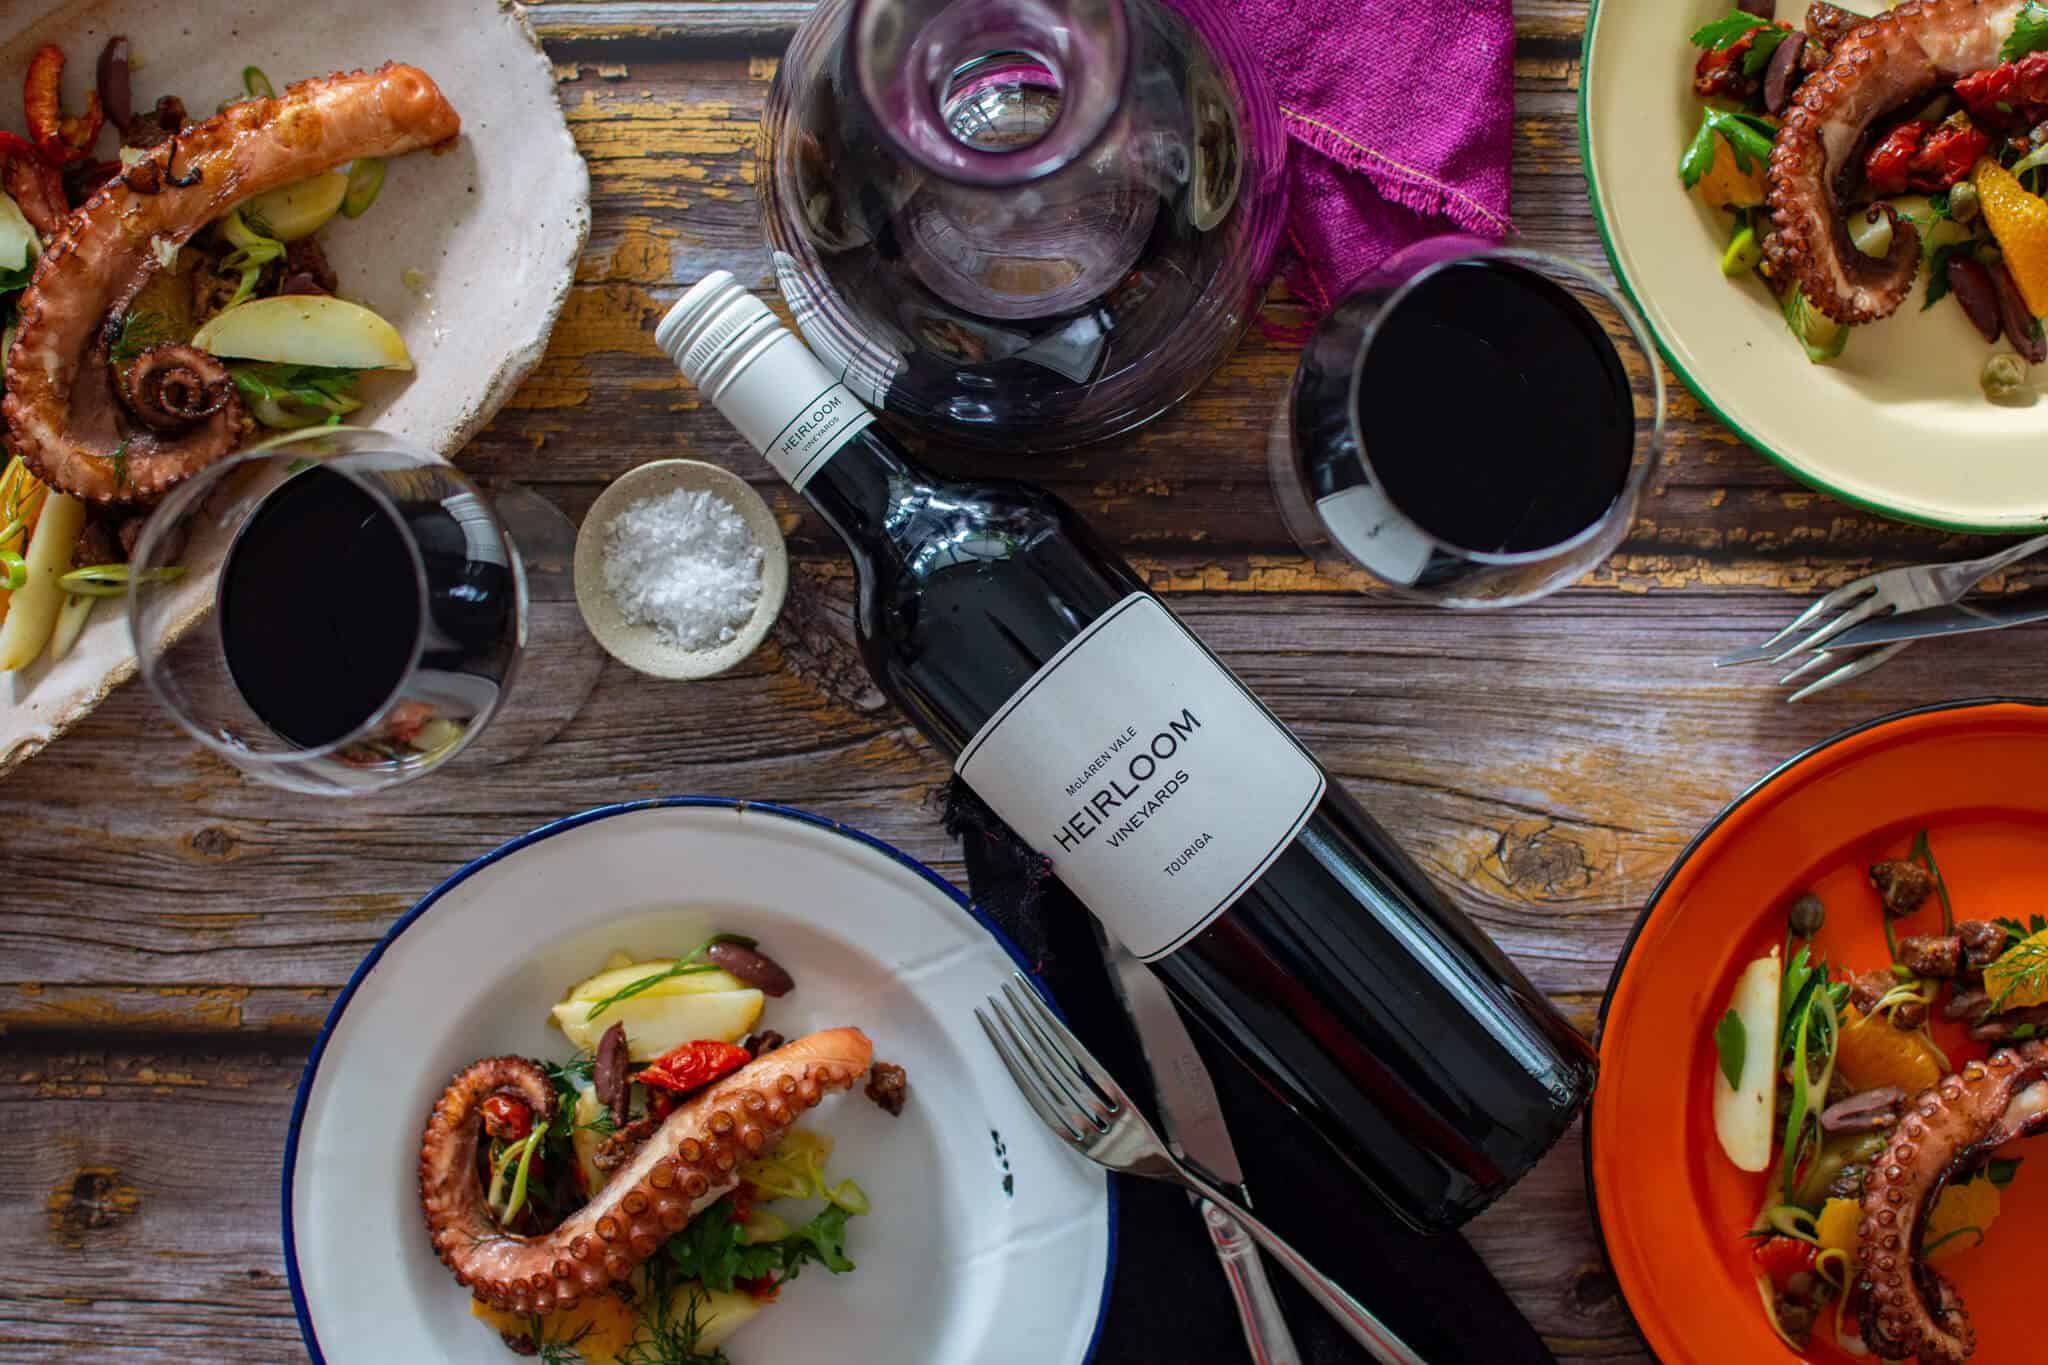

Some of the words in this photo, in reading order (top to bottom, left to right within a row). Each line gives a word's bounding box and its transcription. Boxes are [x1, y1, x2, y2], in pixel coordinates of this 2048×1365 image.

[781, 396, 842, 455] HEIRLOOM
[802, 416, 840, 452] VINEYARDS
[1053, 708, 1201, 853] HEIRLOOM
[1065, 751, 1112, 796] McLAREN
[1109, 726, 1137, 753] VALE
[1105, 769, 1190, 848] VINEYARDS
[1163, 832, 1214, 877] TOURIGA
